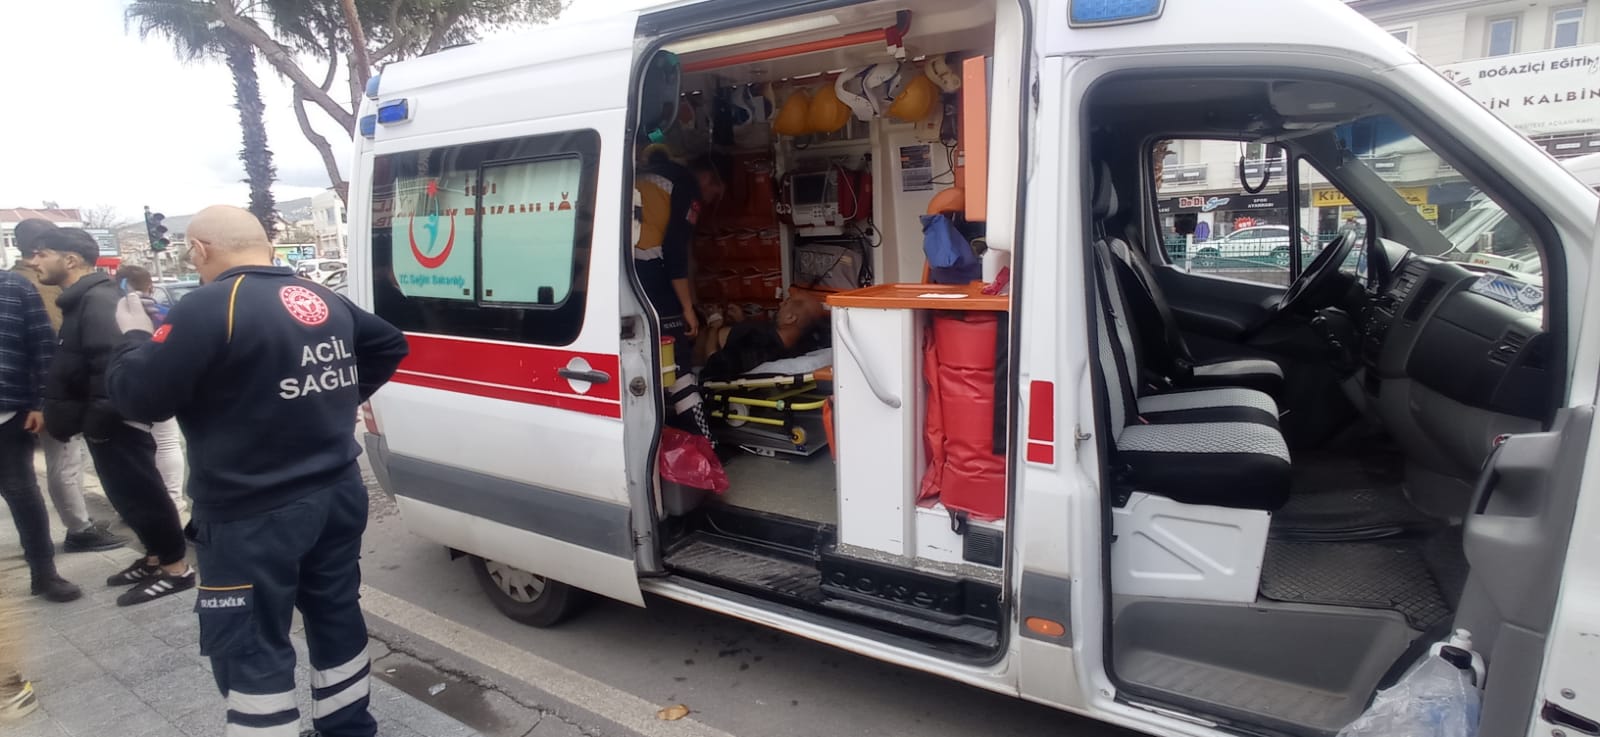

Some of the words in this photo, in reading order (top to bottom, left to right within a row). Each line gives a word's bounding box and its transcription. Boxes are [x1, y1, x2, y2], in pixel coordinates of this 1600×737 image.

[1478, 61, 1545, 79] BOĞAZİÇİ
[1481, 97, 1510, 110] İN
[1523, 87, 1600, 106] KALBİN
[301, 335, 352, 367] ACİL
